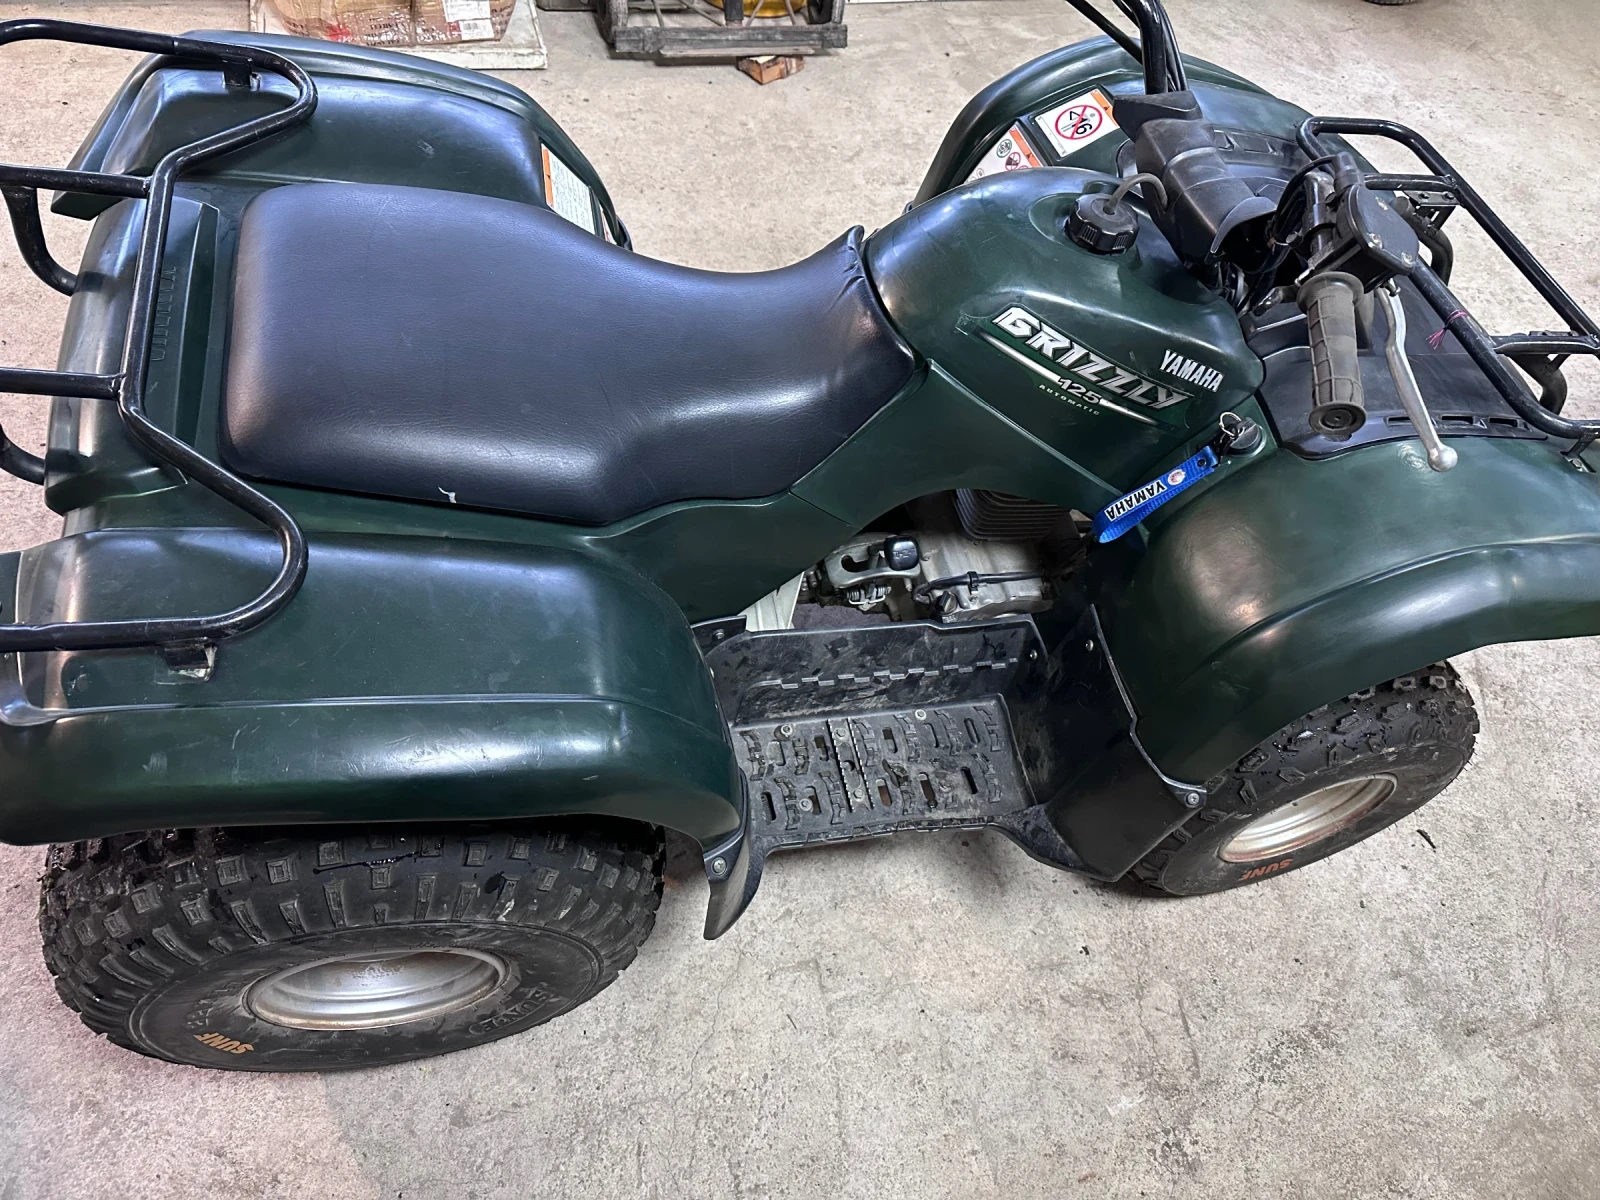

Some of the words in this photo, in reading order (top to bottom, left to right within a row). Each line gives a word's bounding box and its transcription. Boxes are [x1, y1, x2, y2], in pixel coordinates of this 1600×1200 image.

[992, 306, 1192, 410] GRIZZLY
[1159, 350, 1224, 392] YAMAHA
[1039, 384, 1100, 416] AUTOMATIC
[1057, 377, 1103, 404] 125
[1105, 480, 1166, 521] YAMAHA
[1240, 859, 1292, 880] SUNF
[192, 1032, 255, 1054] SUNF
